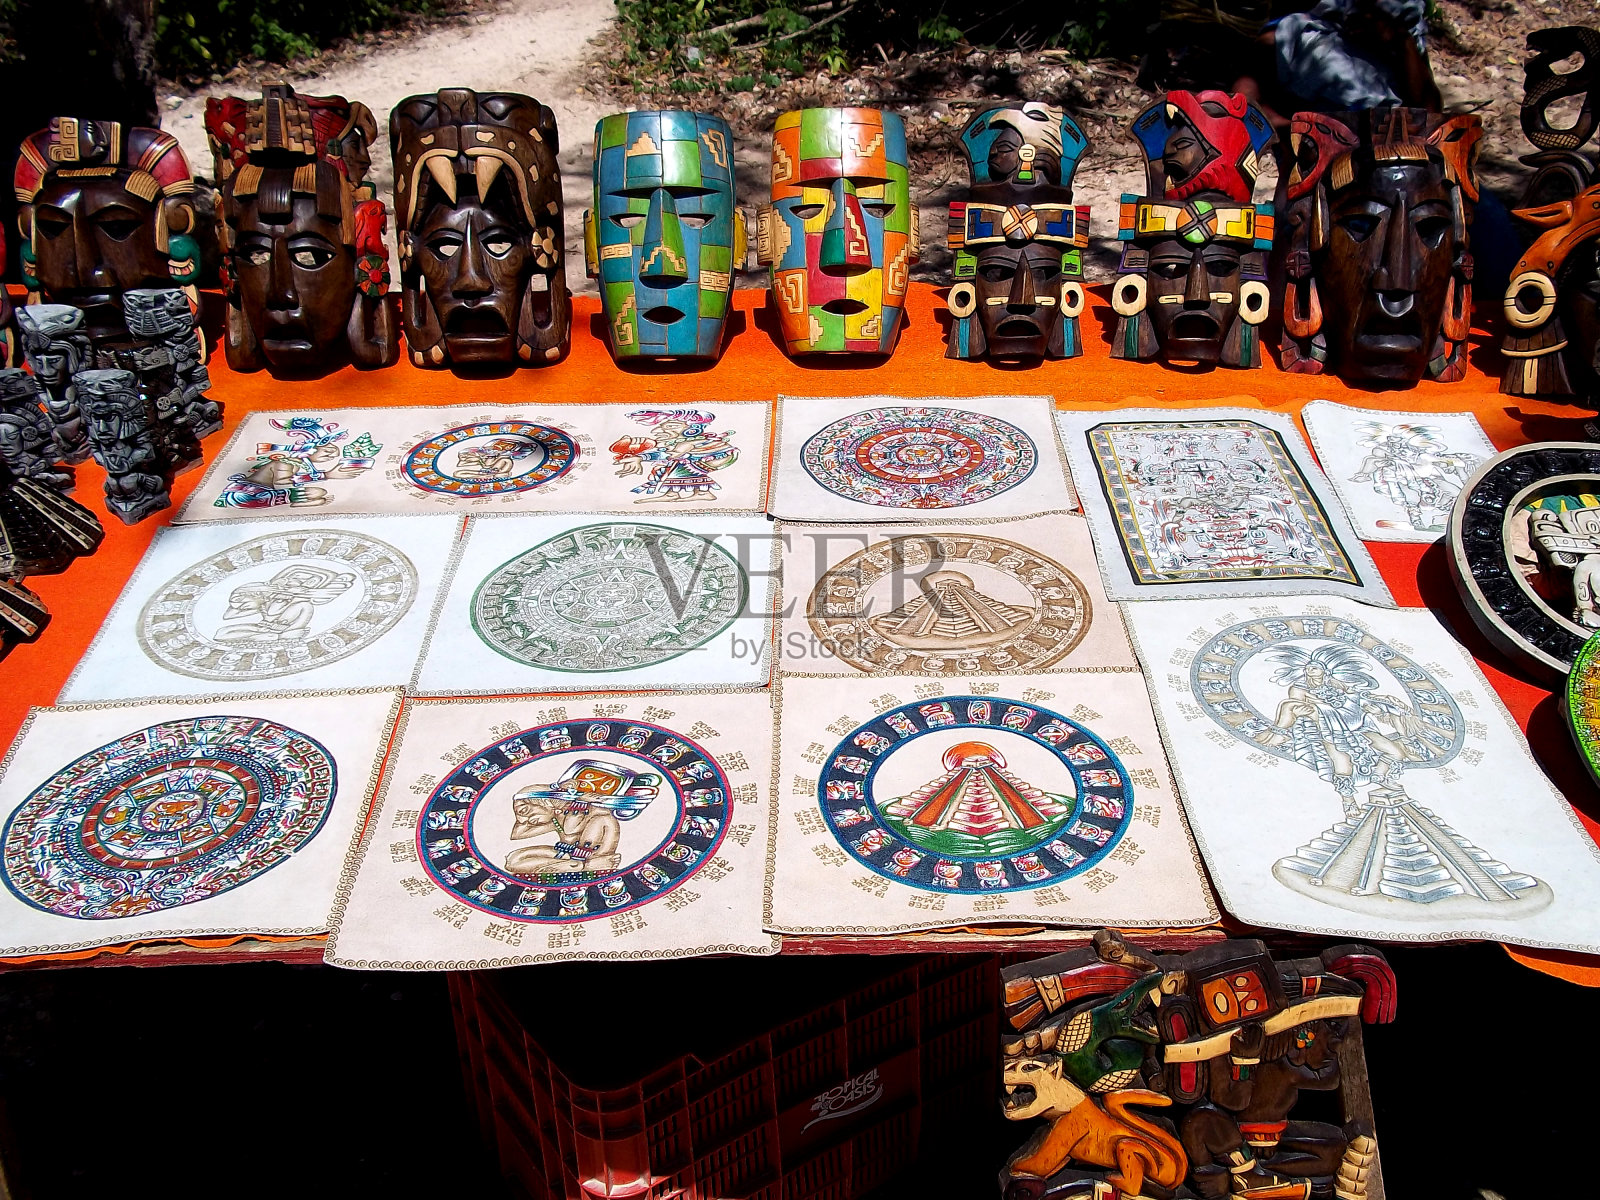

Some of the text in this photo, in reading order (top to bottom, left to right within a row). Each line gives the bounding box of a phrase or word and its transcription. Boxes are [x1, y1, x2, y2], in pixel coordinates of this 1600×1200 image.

[740, 832, 753, 847] NOV
[814, 1068, 880, 1102] TROPICAL
[829, 1081, 876, 1110] OASIS
